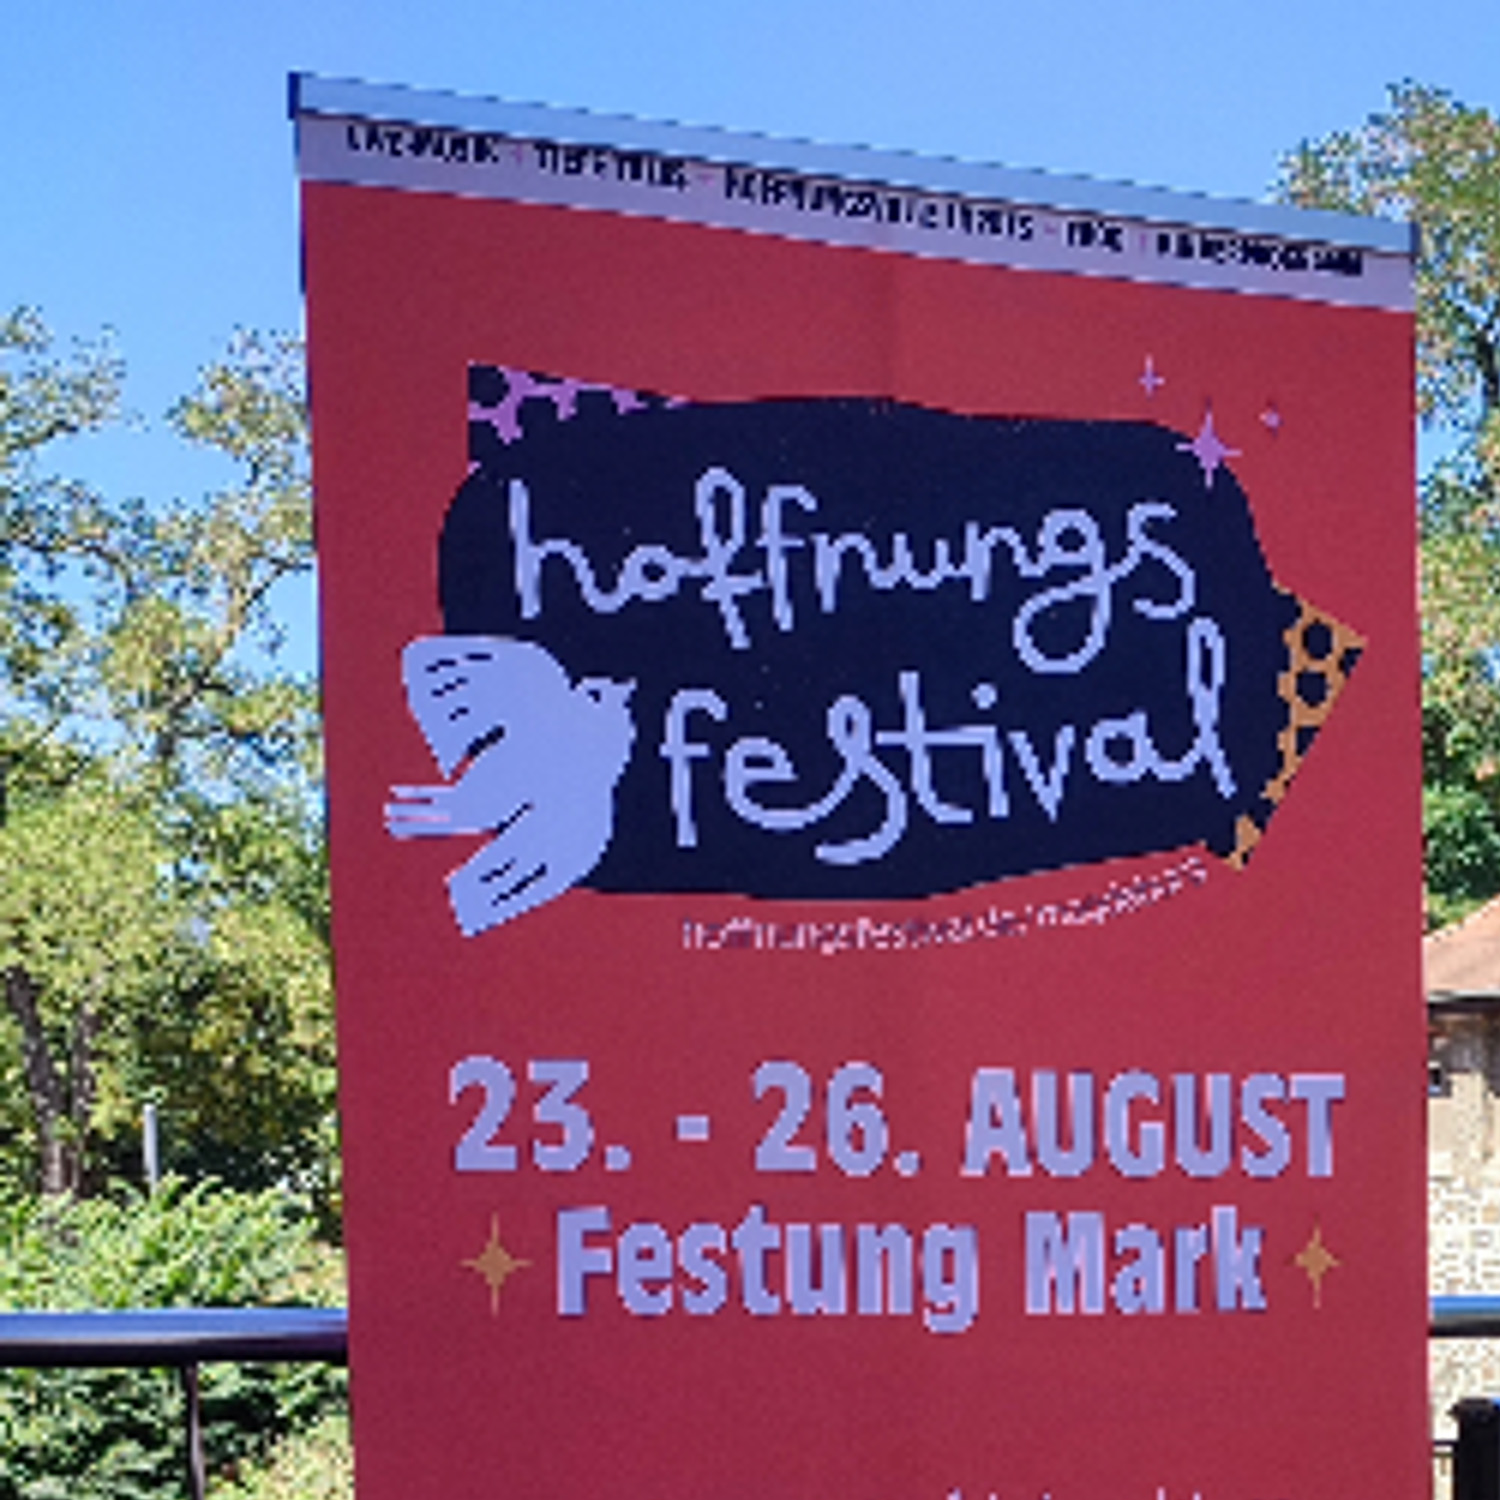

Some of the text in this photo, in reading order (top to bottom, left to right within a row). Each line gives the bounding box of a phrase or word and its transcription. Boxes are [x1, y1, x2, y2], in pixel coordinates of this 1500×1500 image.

[508, 466, 1196, 674] hoffnungs
[658, 616, 1238, 866] festival
[447, 1055, 1347, 1179] 23. - 26. AUGUST
[555, 1205, 1268, 1334] Festung Mark
